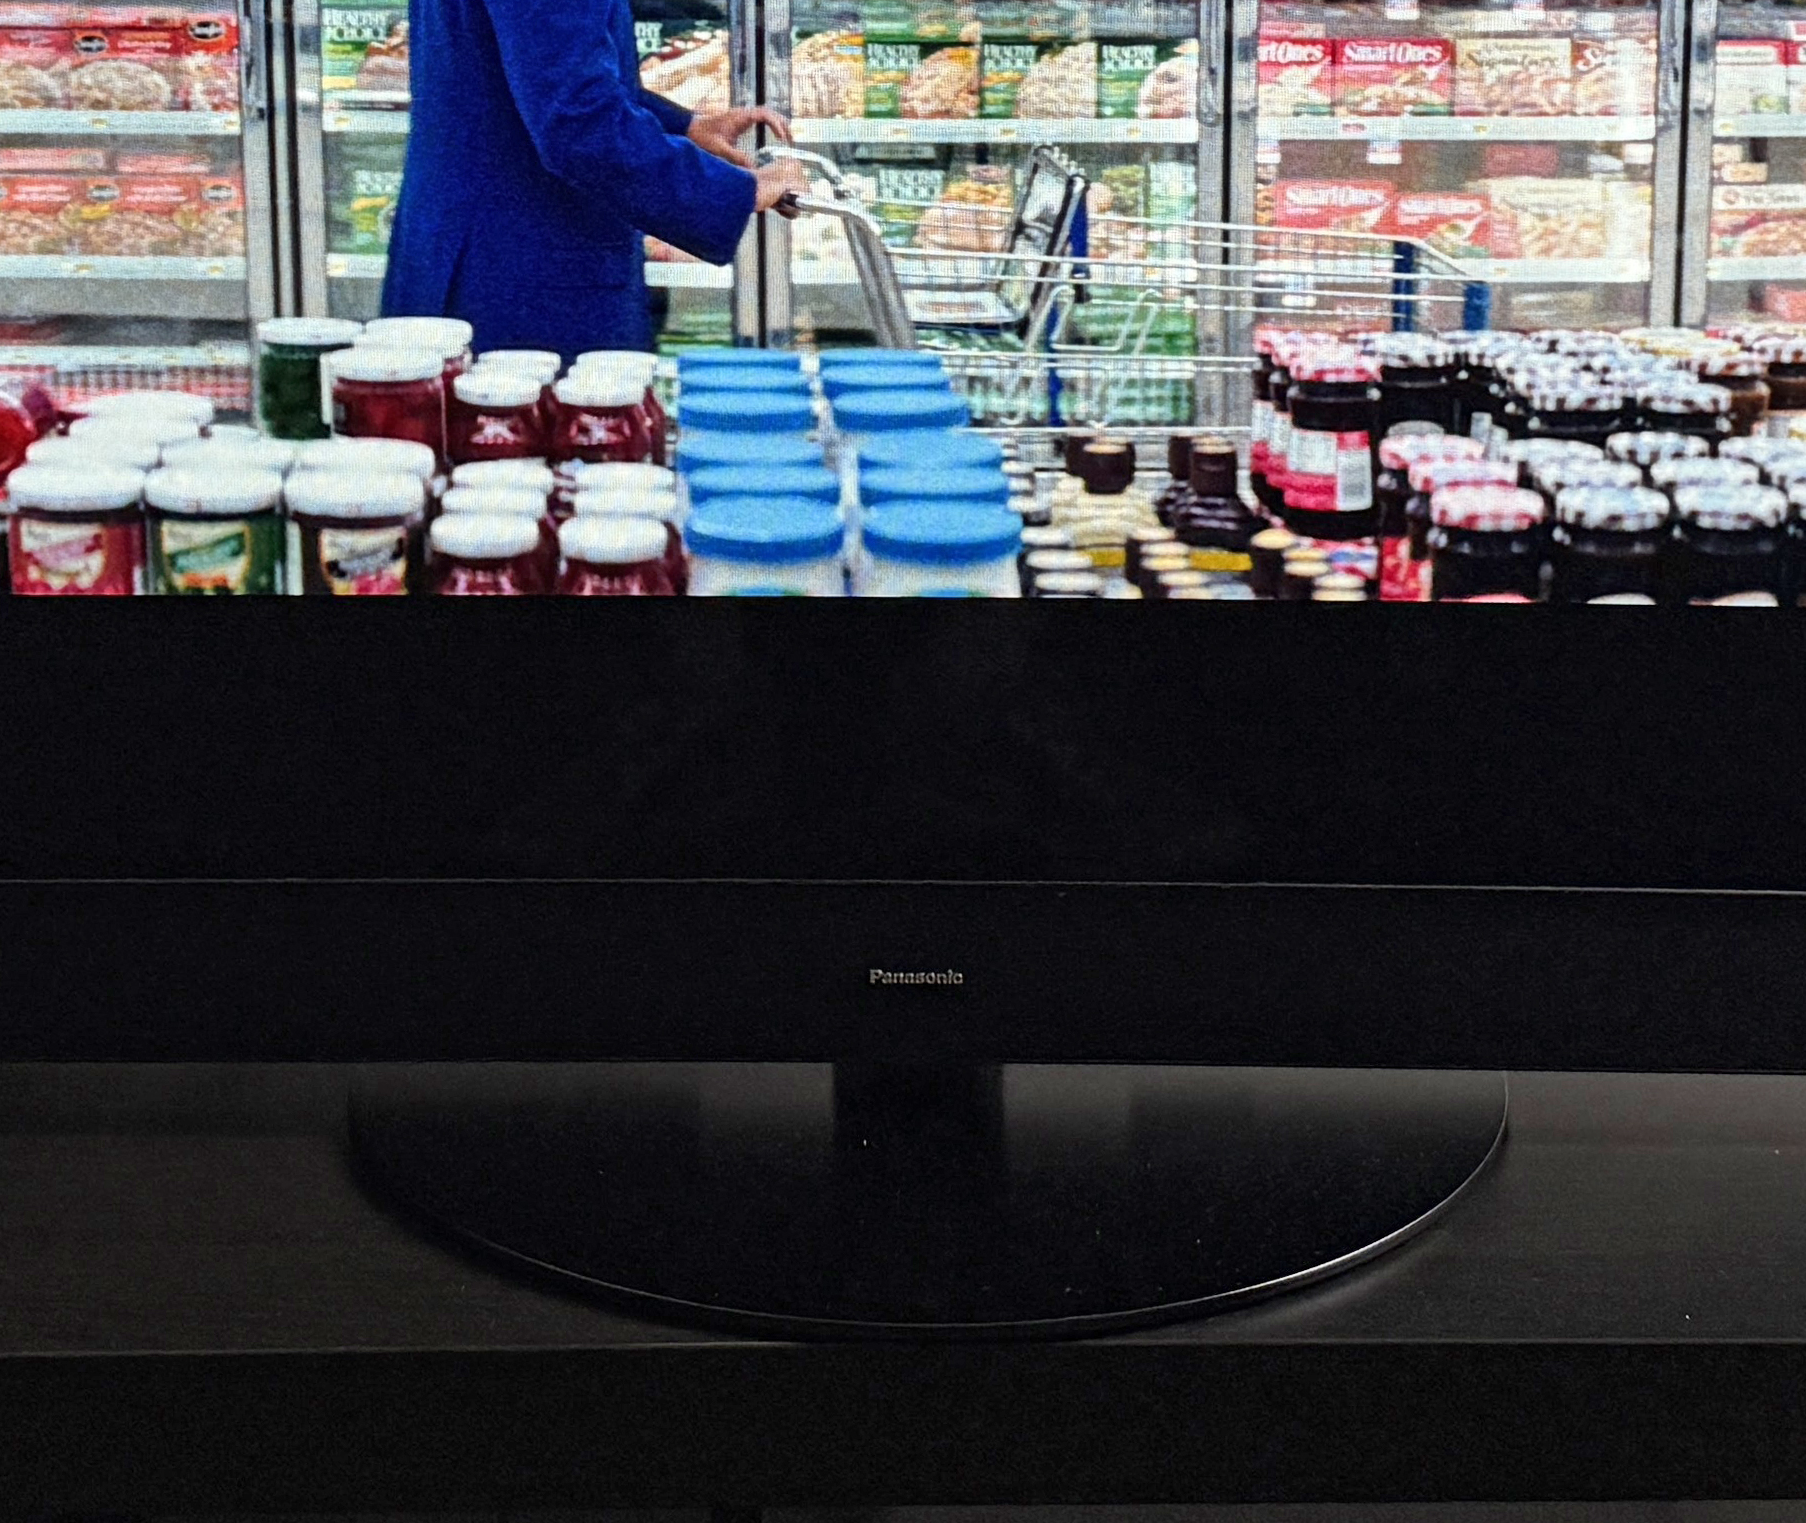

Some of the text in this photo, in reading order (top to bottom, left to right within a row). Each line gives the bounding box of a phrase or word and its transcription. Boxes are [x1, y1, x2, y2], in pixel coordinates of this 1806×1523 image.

[1343, 42, 1397, 63] Smart
[1397, 42, 1442, 64] Ones
[868, 969, 964, 985] Panasonic
